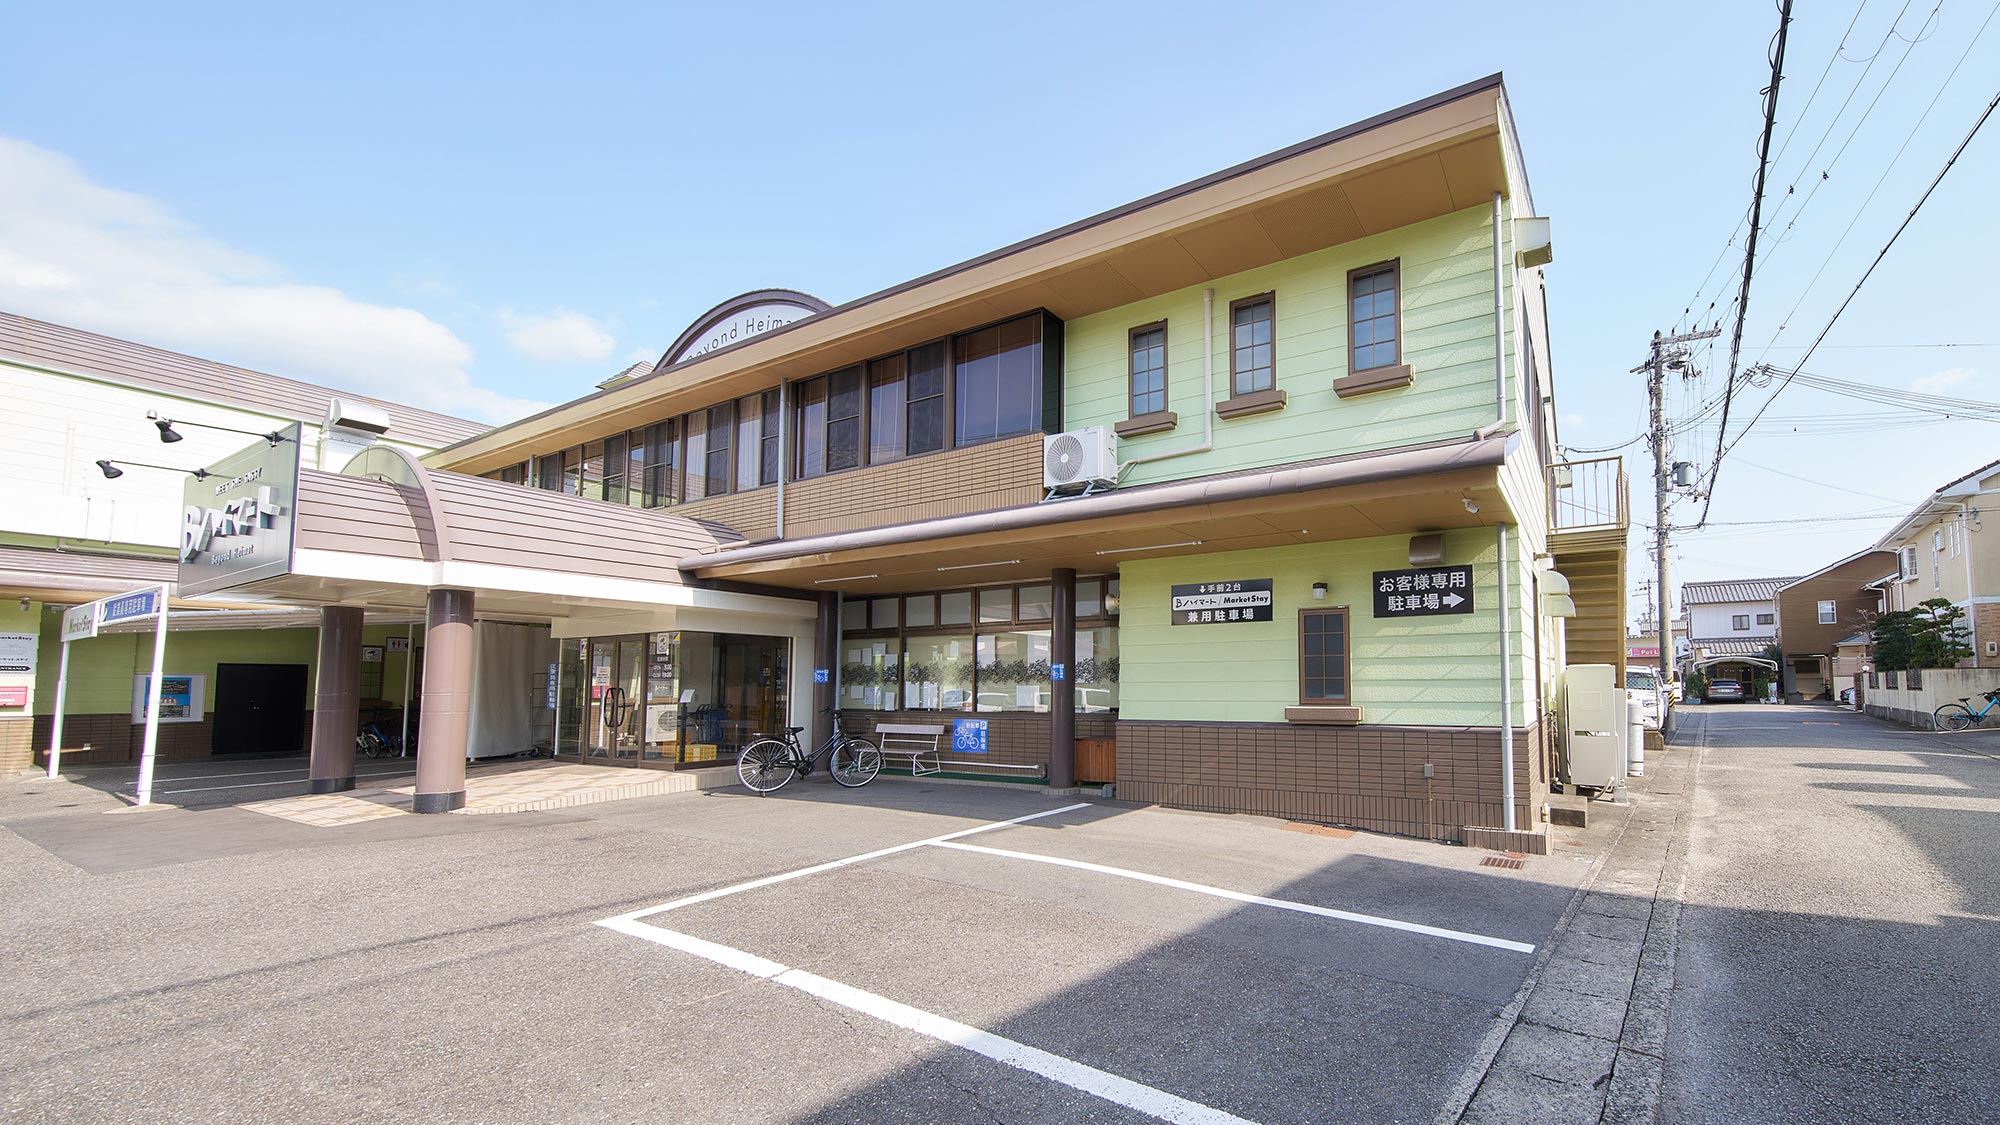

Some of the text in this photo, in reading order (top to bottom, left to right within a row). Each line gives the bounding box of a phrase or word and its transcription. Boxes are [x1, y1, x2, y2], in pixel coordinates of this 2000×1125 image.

[1207, 583, 1242, 593] 手前2台
[1379, 571, 1466, 592] お客様専用
[1387, 593, 1440, 612] 駐車場
[1187, 608, 1254, 622] 兼用駐車場
